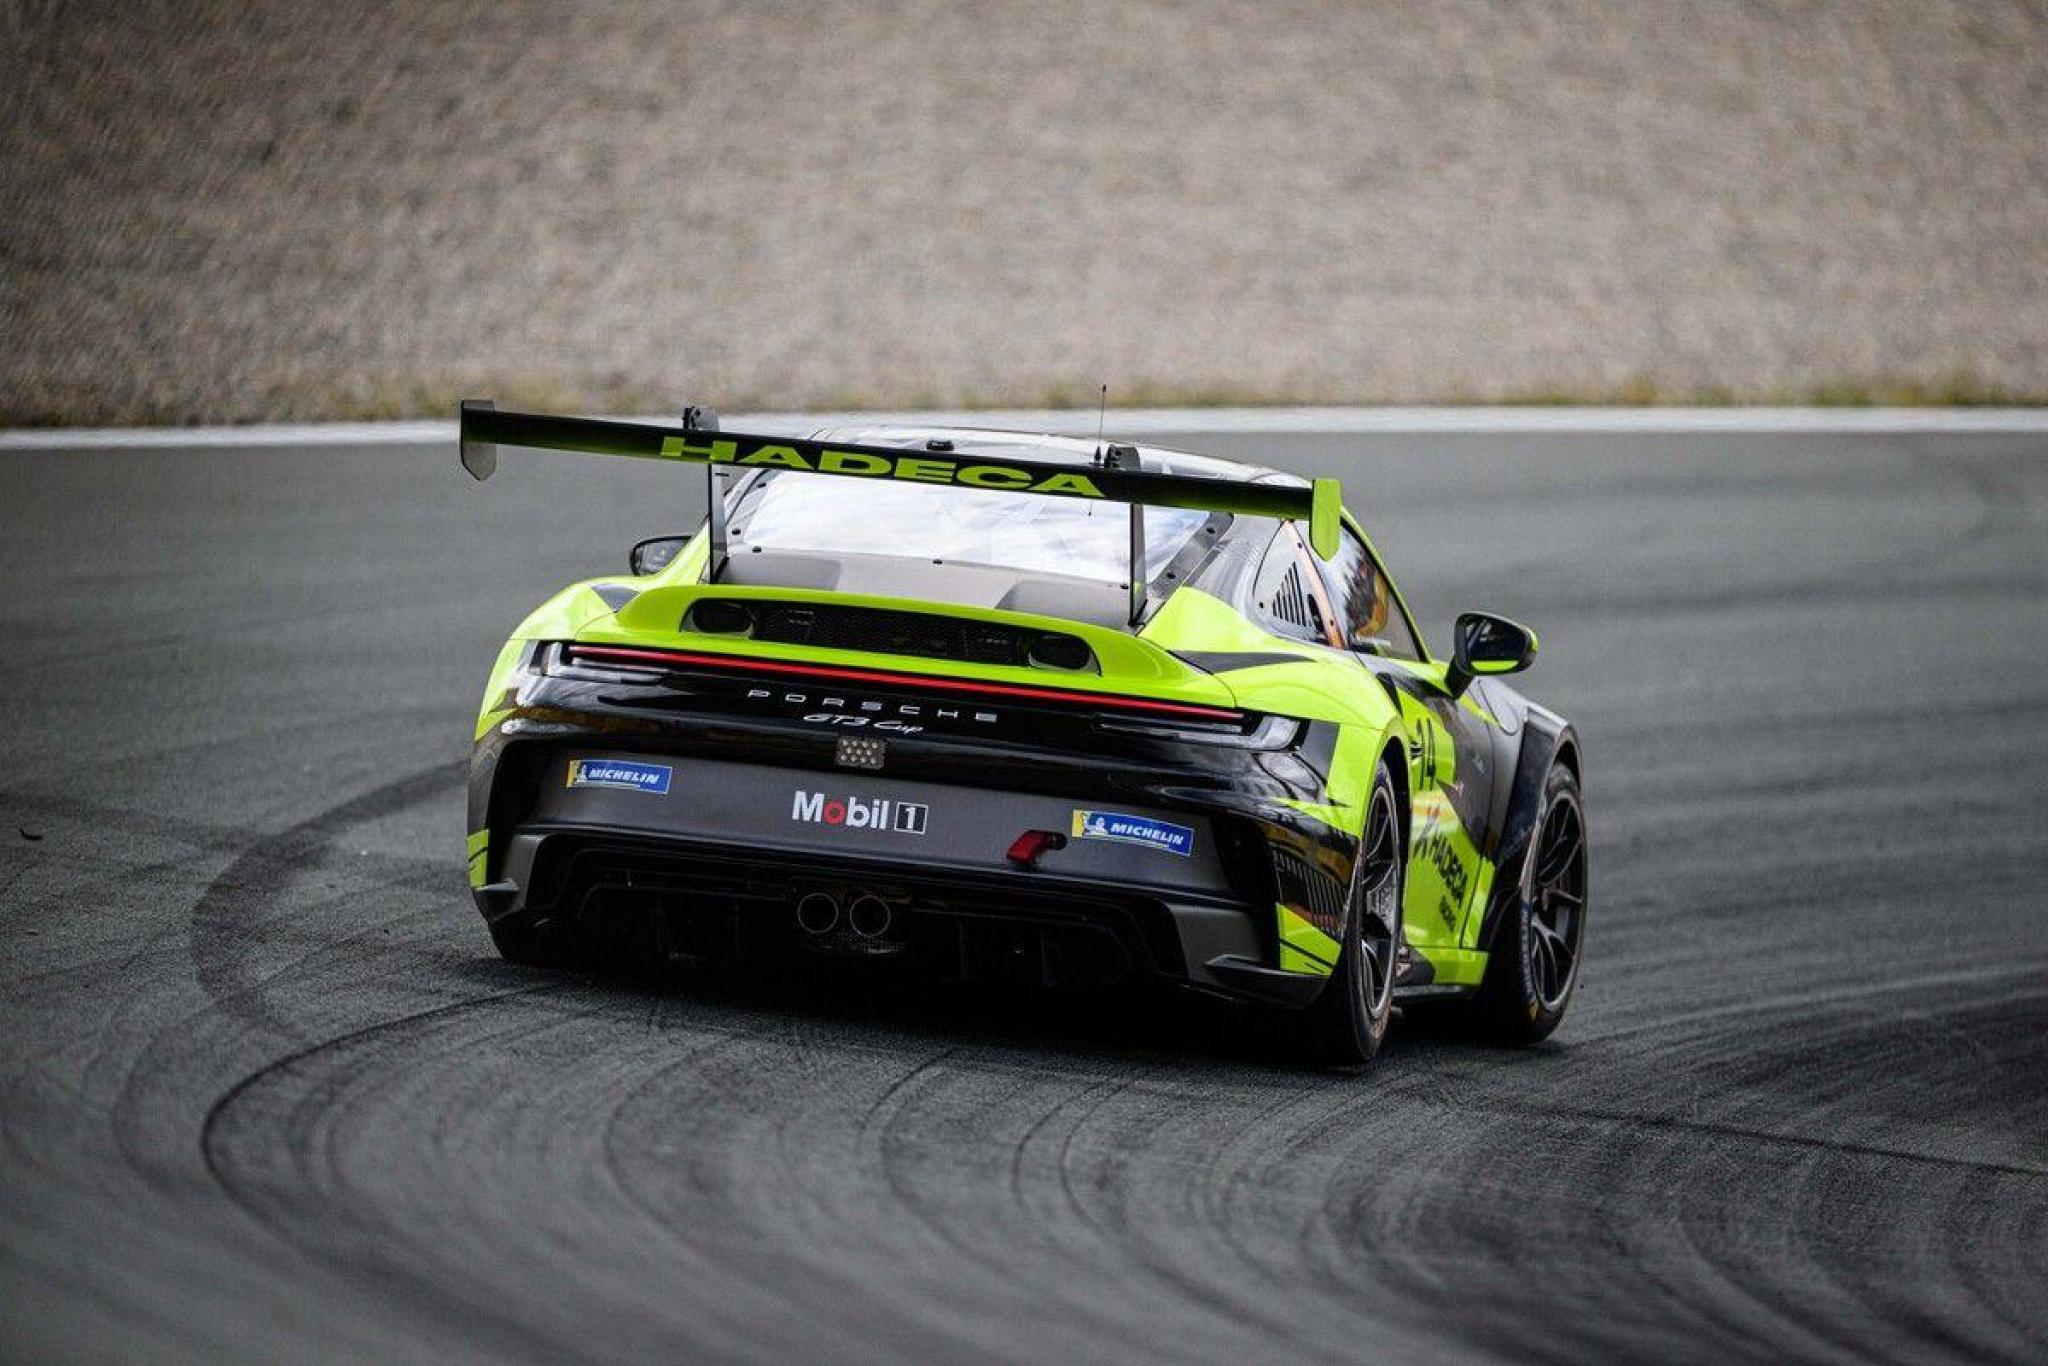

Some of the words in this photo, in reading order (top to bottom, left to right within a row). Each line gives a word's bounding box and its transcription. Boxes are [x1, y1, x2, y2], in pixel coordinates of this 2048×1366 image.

[661, 436, 1107, 498] HADECA
[747, 689, 998, 723] PORSCHE
[803, 713, 870, 726] GT3
[873, 720, 924, 734] Cup
[588, 769, 660, 785] MICHELIN
[791, 790, 890, 830] Mobil
[1110, 822, 1184, 845] MICHELIN
